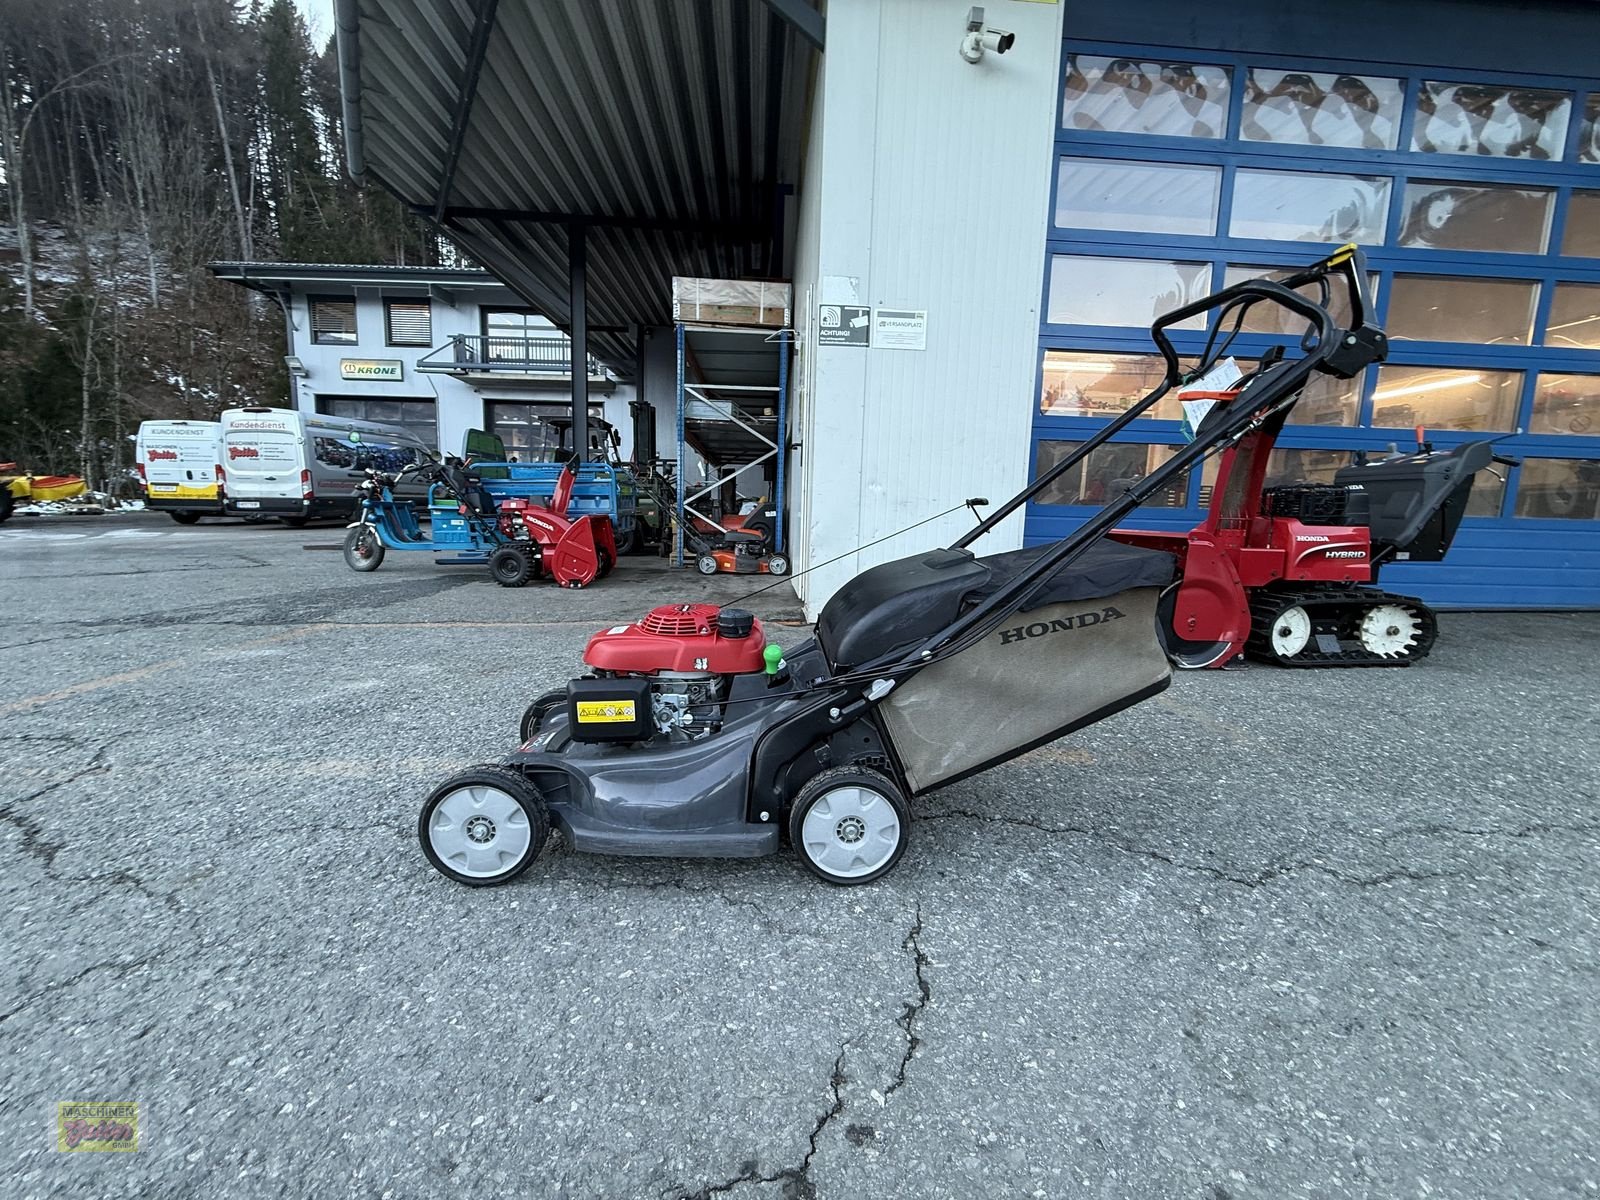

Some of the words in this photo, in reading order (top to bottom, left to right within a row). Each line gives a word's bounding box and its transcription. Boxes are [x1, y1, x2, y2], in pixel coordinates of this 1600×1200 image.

[820, 329, 850, 337] ACHTUNG!
[230, 421, 286, 429] Kundendienst
[526, 515, 554, 531] HONDA
[1325, 551, 1366, 559] HYBRID
[999, 606, 1126, 645] HONDA
